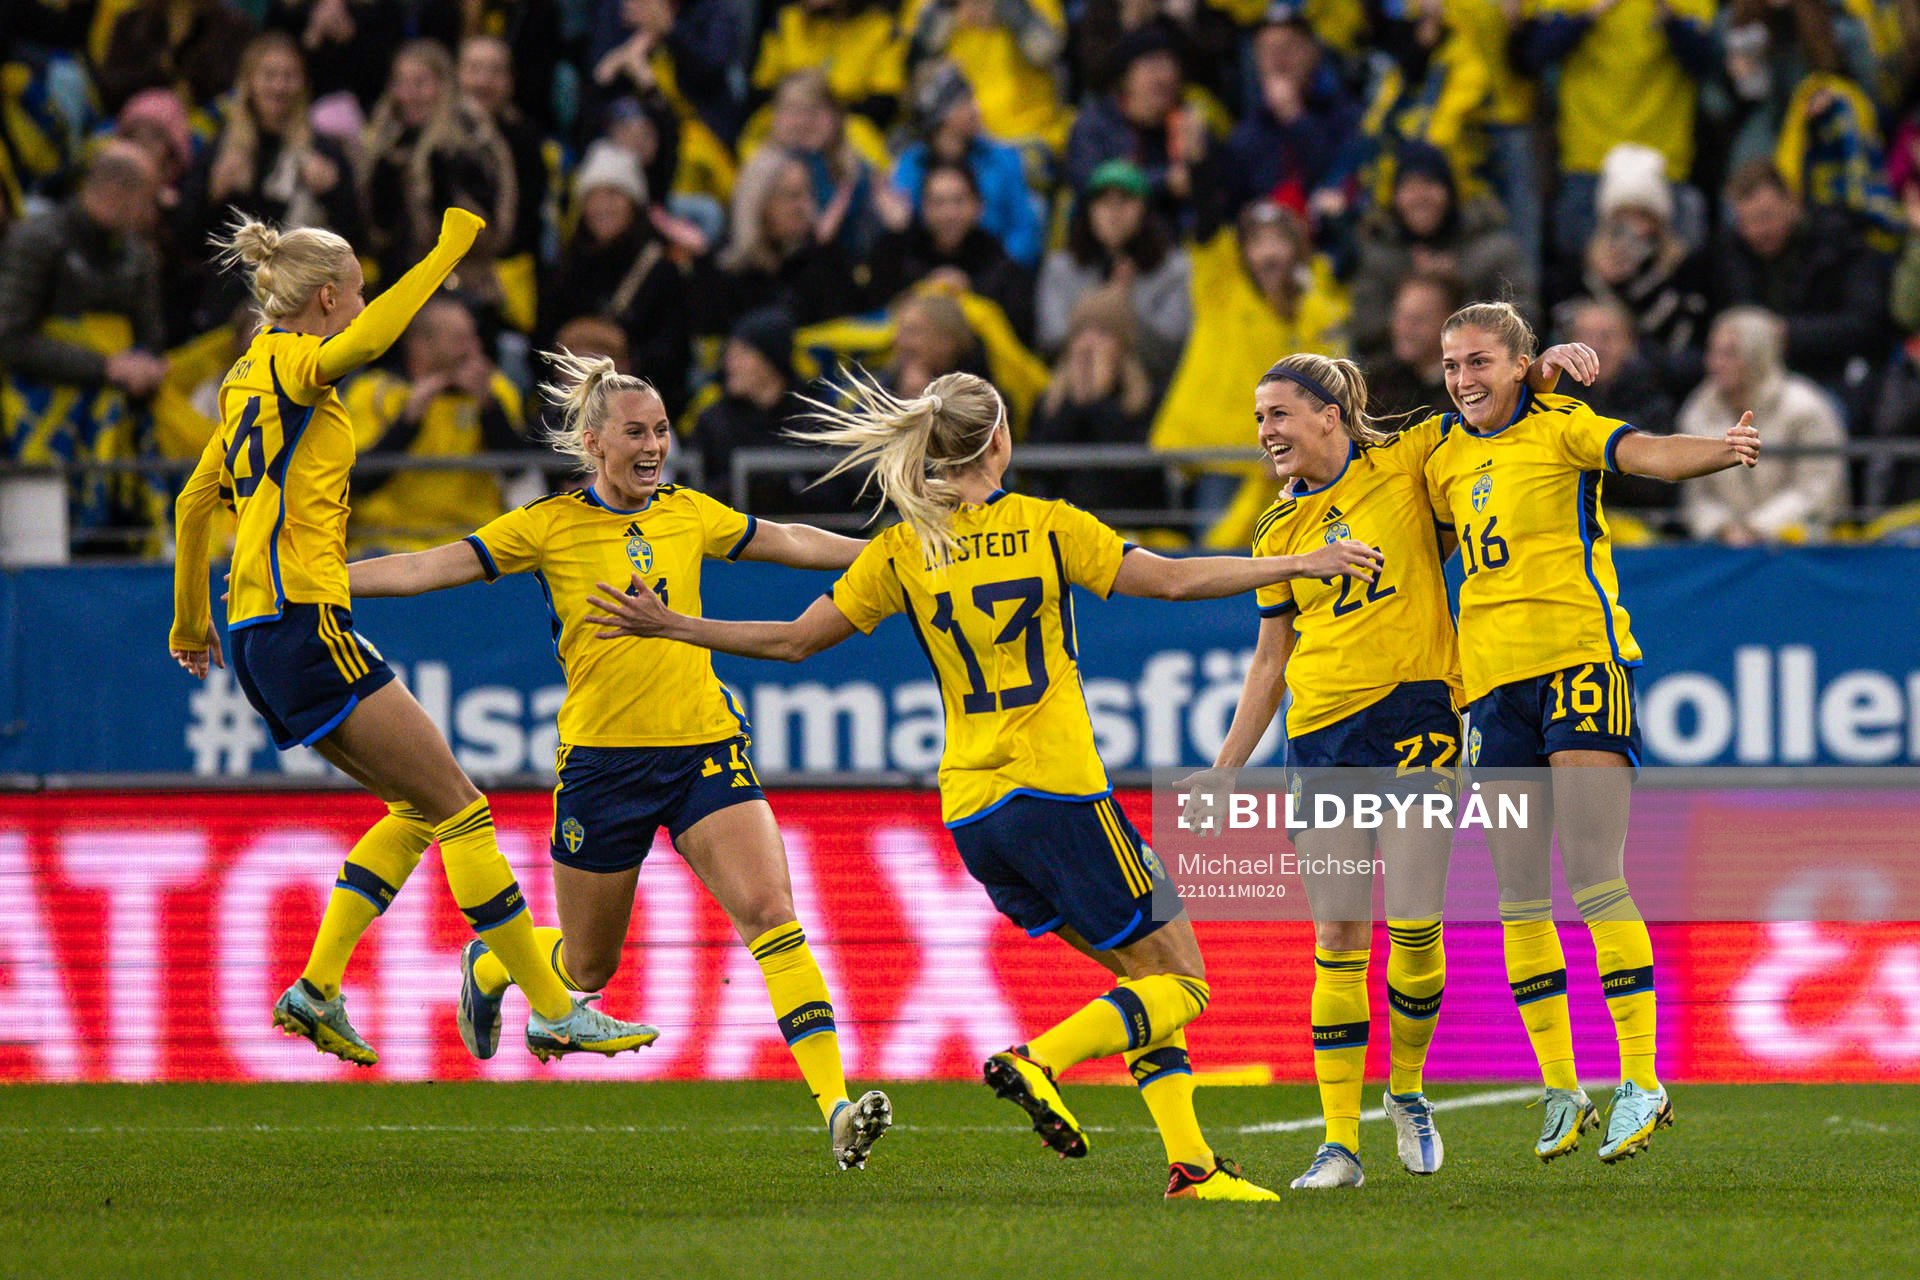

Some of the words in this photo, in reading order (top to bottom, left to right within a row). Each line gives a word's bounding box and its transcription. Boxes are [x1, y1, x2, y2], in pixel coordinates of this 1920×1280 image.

[1462, 516, 1510, 576] 16
[931, 576, 1050, 714] 13
[1550, 664, 1603, 720] 16
[1394, 732, 1457, 779] 22
